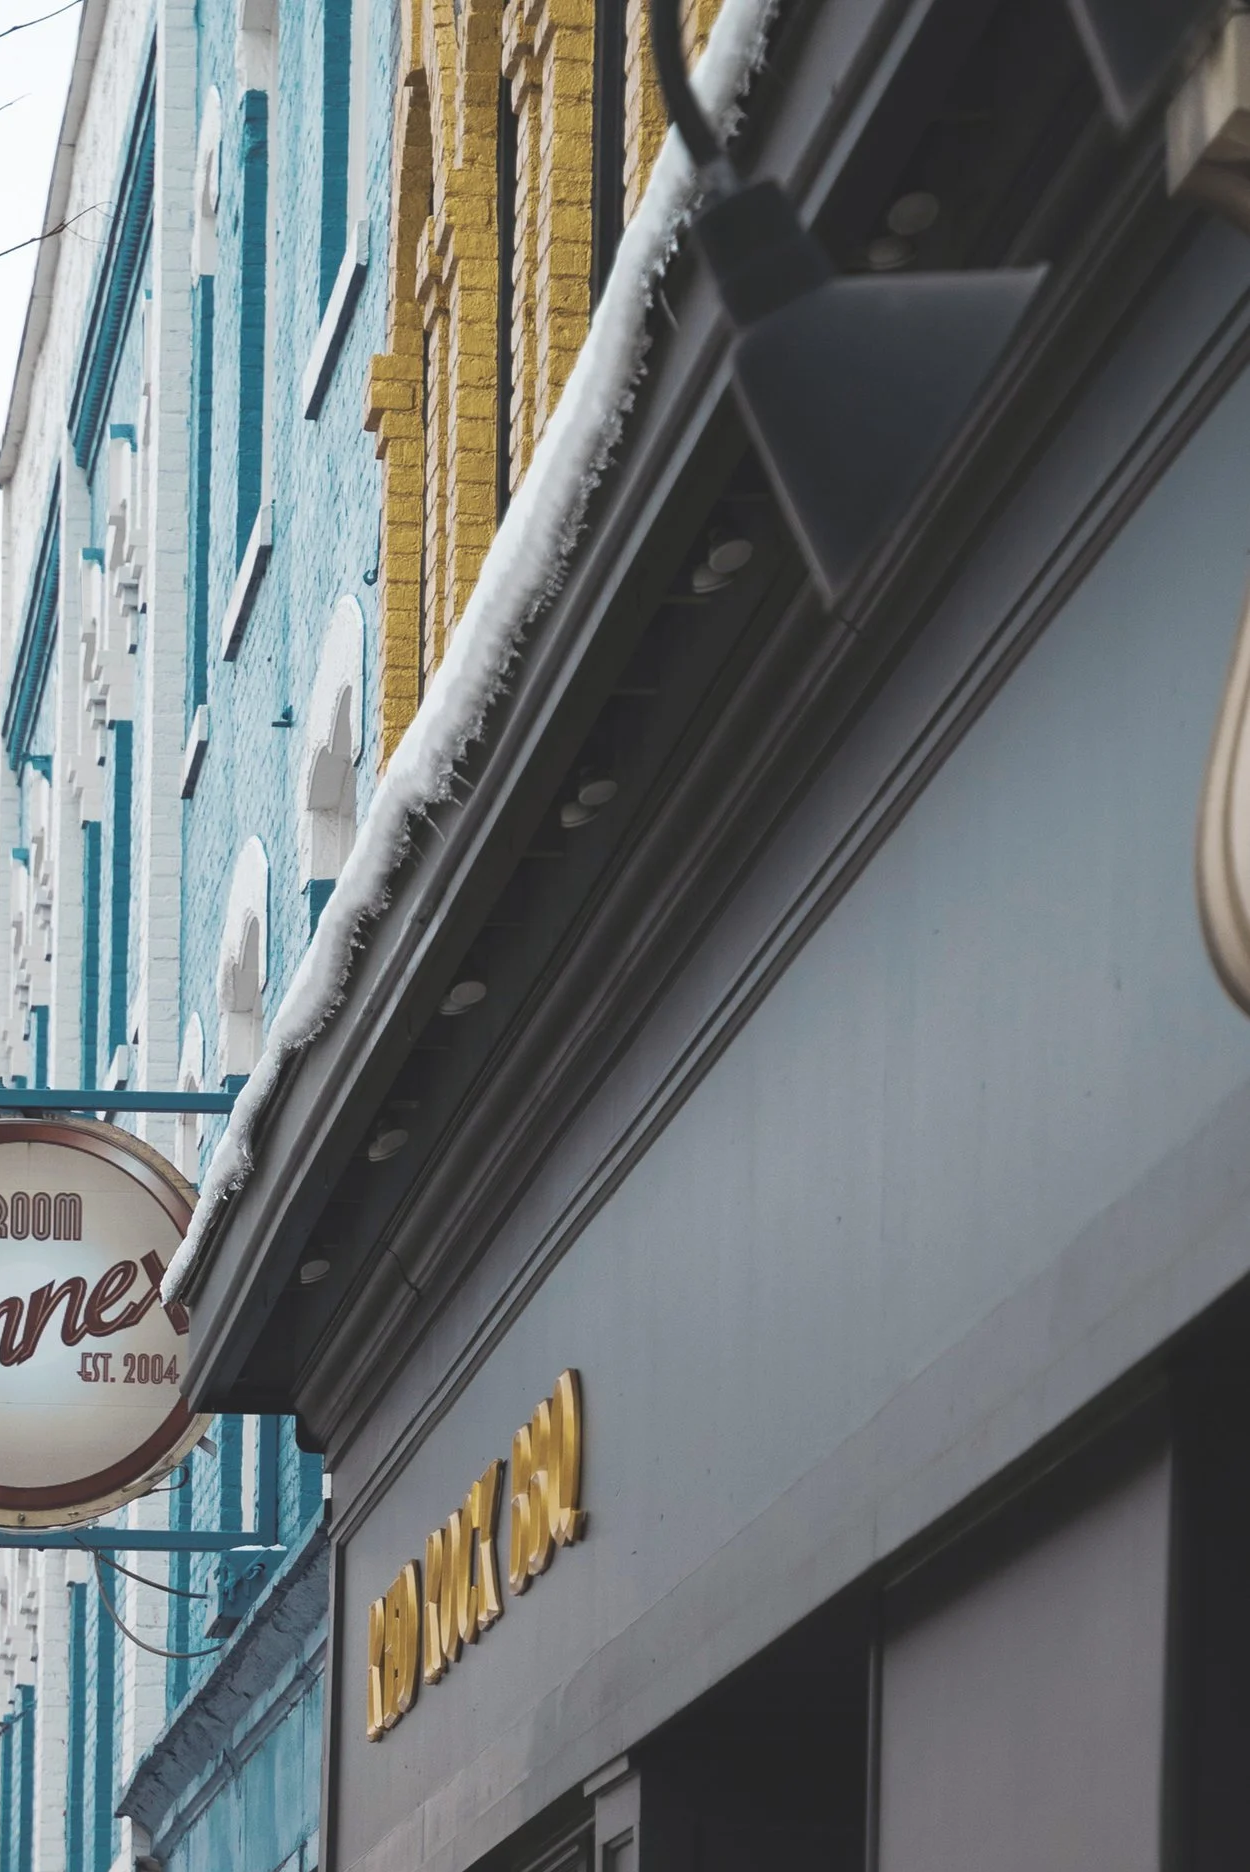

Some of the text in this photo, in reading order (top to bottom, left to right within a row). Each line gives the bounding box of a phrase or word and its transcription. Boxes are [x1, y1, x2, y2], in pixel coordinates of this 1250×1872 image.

[76, 1352, 180, 1385] EST. 2004
[423, 1457, 505, 1685] ROCK
[508, 1367, 587, 1597] BBQ
